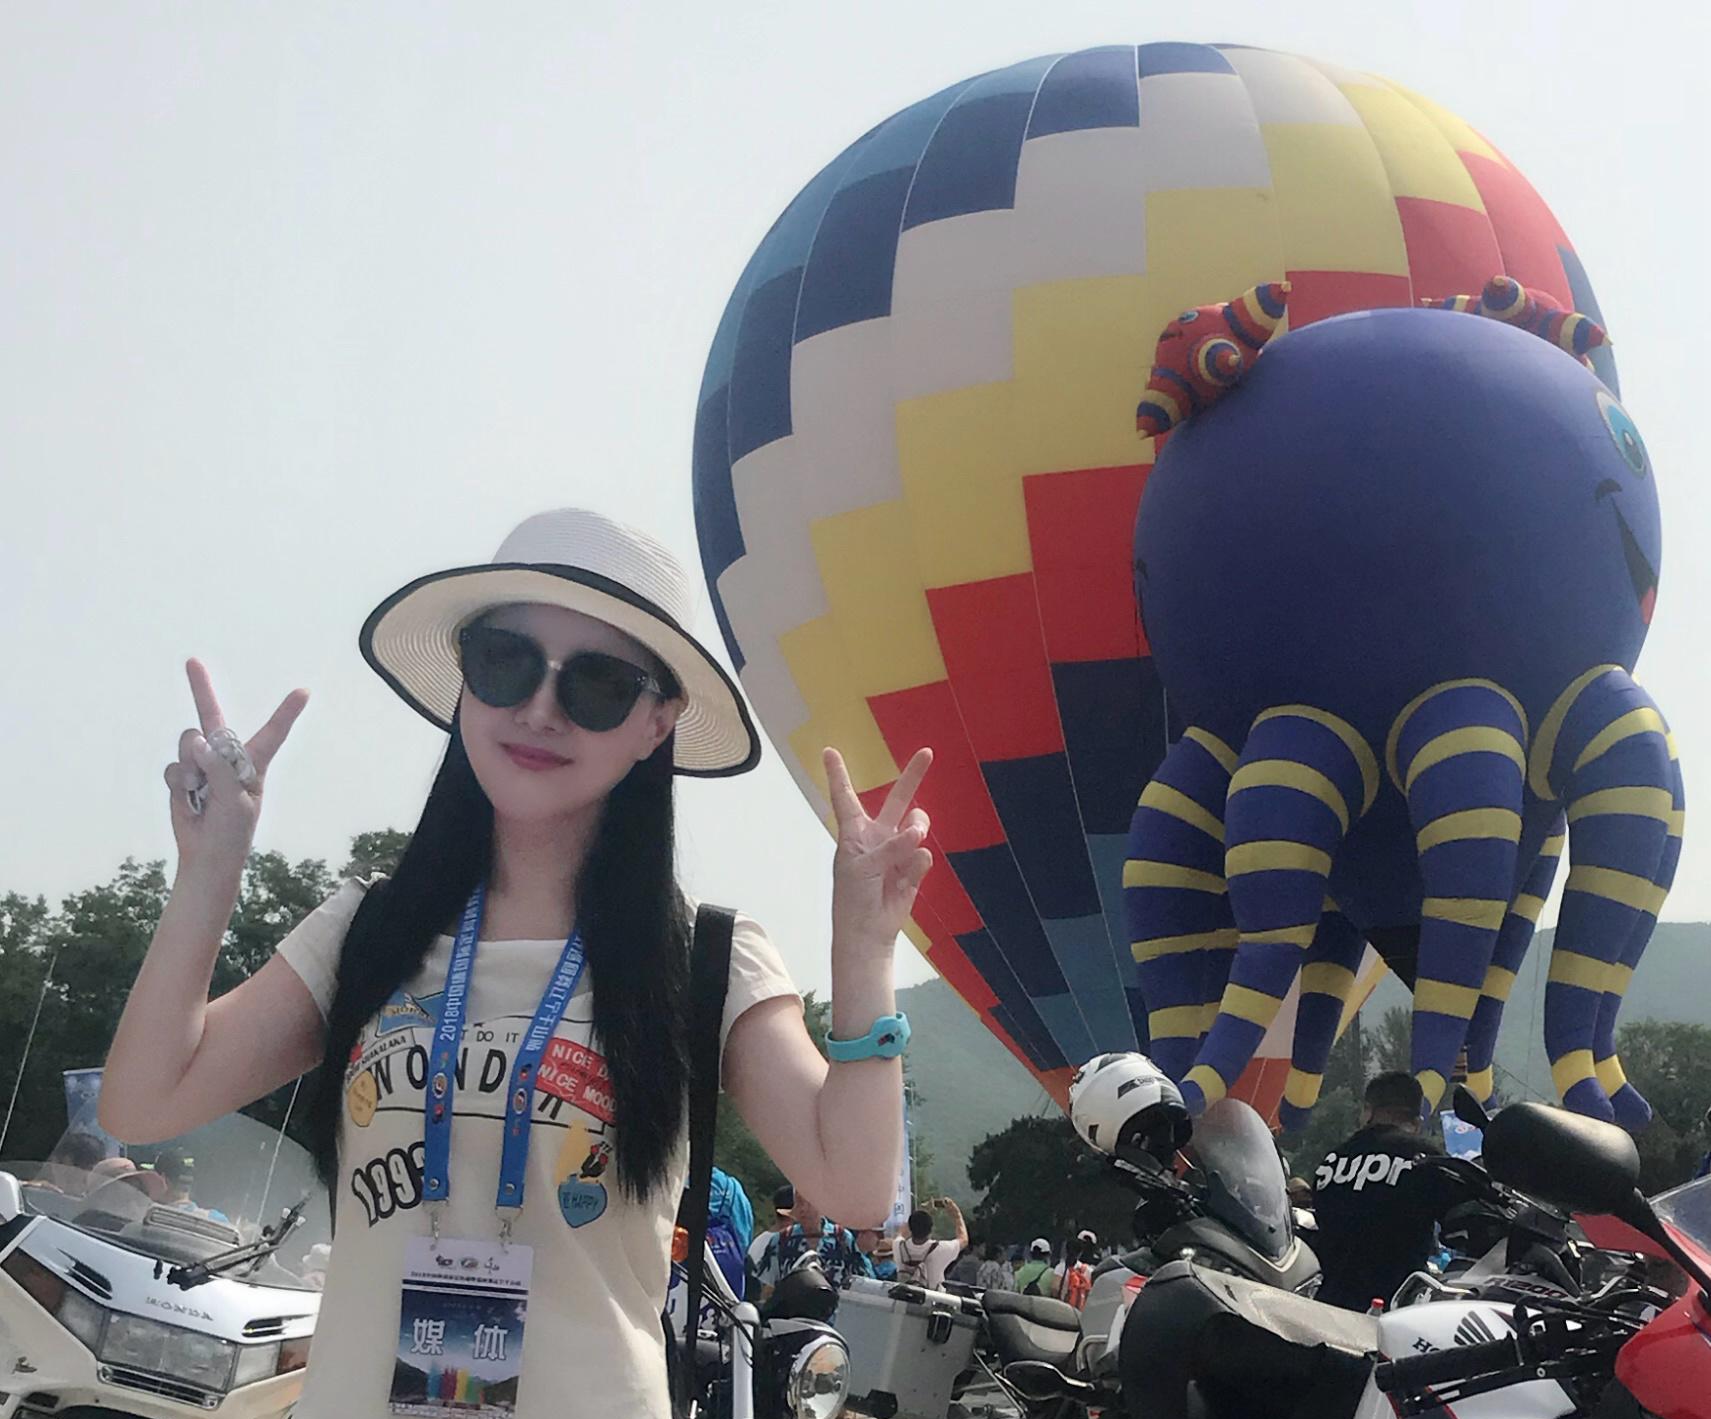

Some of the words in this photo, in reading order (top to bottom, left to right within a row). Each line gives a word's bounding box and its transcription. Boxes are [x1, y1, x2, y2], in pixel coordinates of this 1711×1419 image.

[476, 1031, 494, 1042] DO
[506, 1032, 519, 1043] IT
[552, 1044, 594, 1070] NICE
[537, 1064, 579, 1093] NICE
[410, 1318, 509, 1361] 媒体
